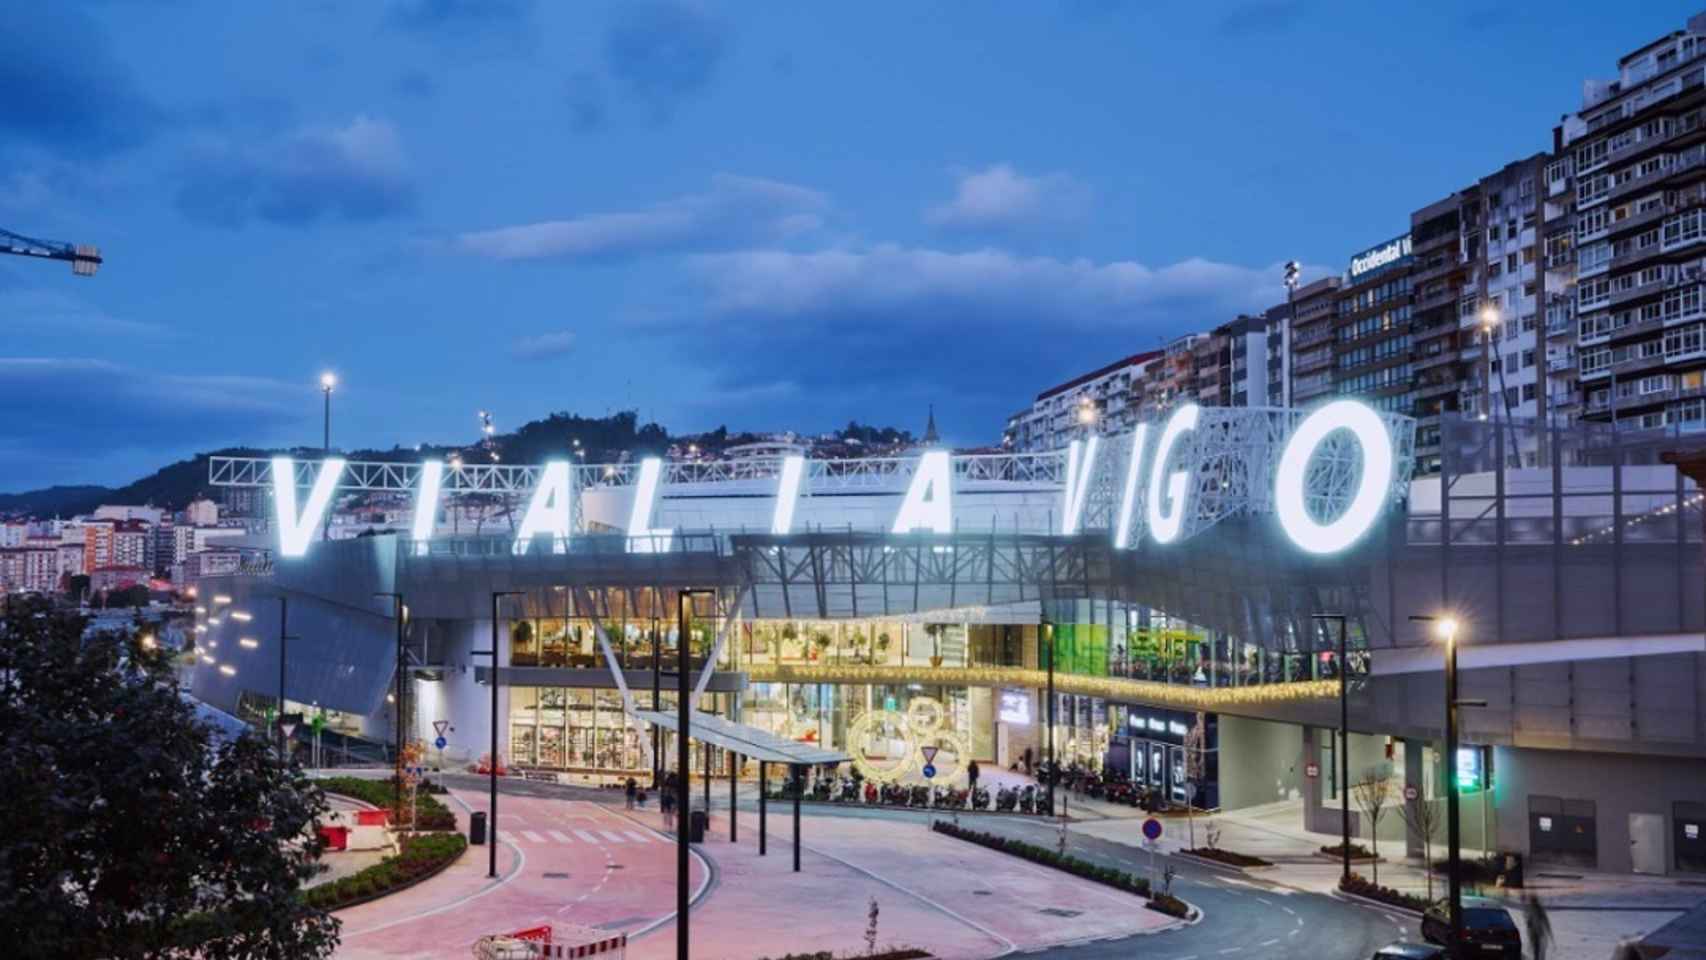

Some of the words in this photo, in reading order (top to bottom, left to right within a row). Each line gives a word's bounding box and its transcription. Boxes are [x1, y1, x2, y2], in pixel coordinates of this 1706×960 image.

[1351, 240, 1400, 276] Occidental
[271, 451, 953, 556] VIALIA
[1062, 400, 1393, 553] VIGO
